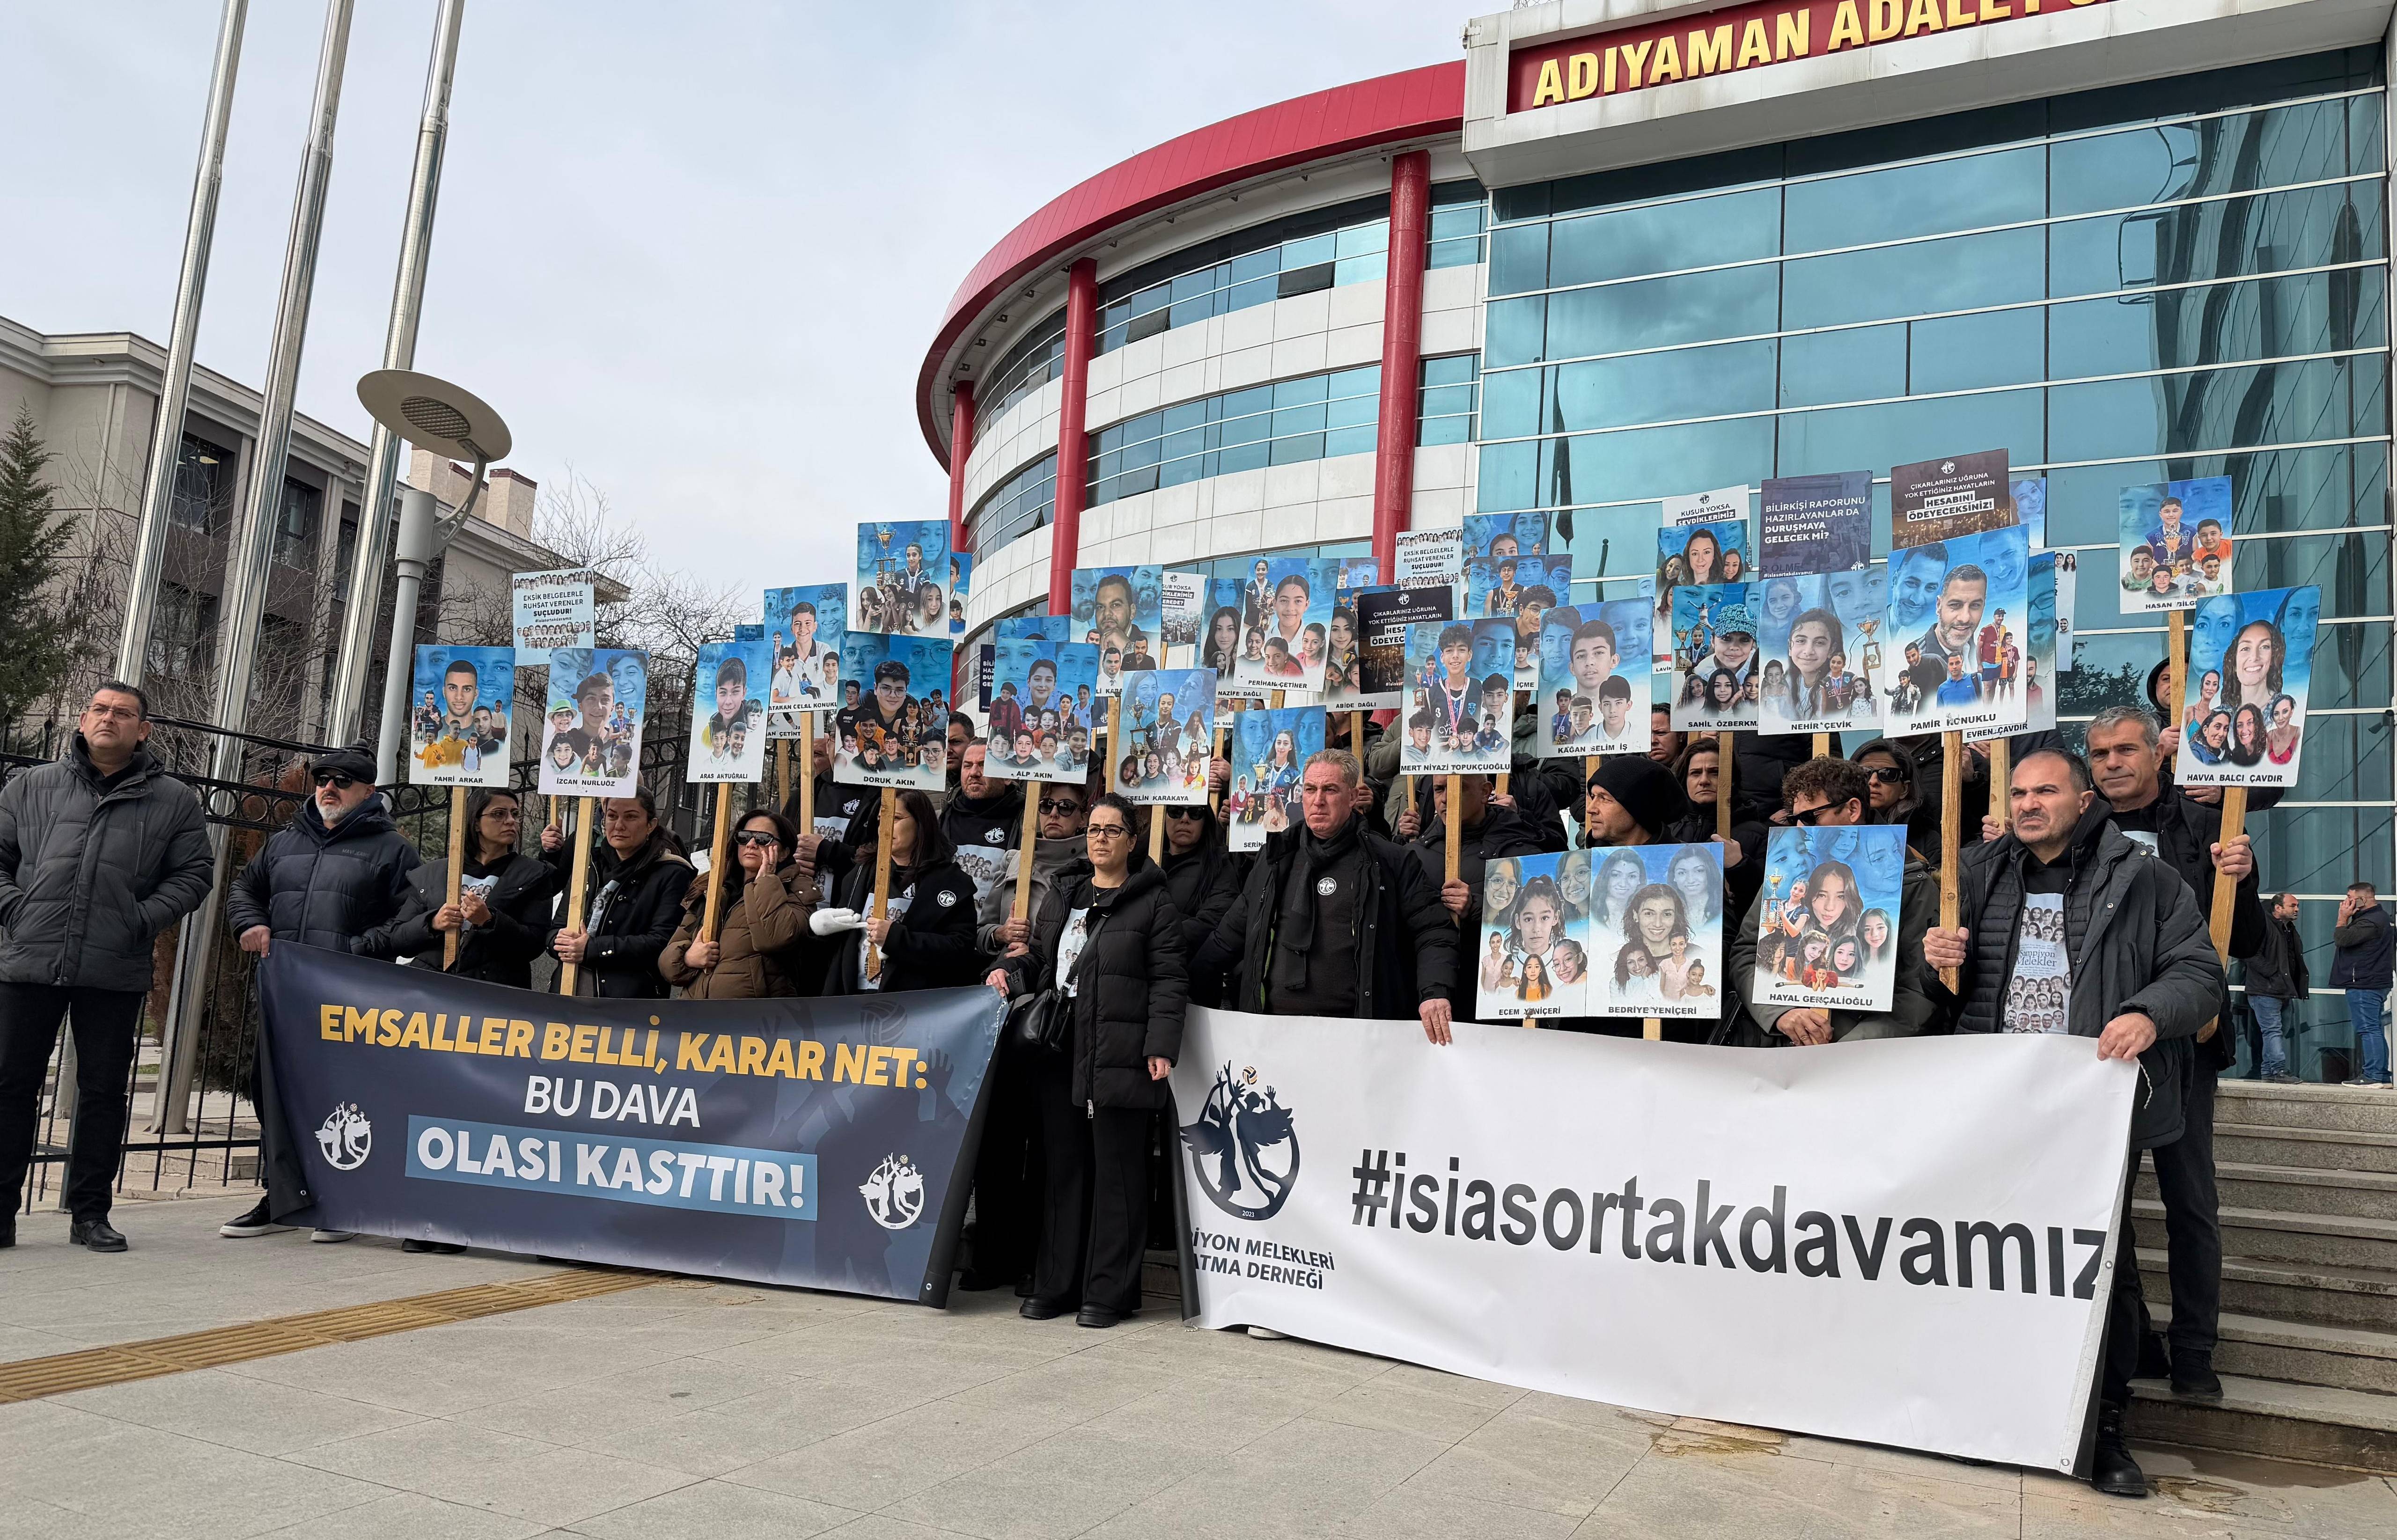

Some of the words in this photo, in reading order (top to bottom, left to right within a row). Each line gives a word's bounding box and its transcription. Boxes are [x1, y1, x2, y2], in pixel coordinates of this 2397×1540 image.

[1532, 8, 1809, 107] ADIYAMAN
[1827, 0, 2040, 50] ADAL
[1911, 477, 1957, 490] ÇIKARLARINIZ
[1958, 472, 1988, 482] UĞRUNA
[1919, 485, 1952, 496] ETTİĞİNİZ
[1954, 480, 1995, 491] HAYATLARIN
[1766, 500, 1807, 513] BİLİRKİŞİ
[1809, 497, 1865, 509] RAPORUNU
[1926, 493, 1973, 507] HESABINI
[1681, 508, 1705, 517] KUSUR
[1706, 503, 1730, 512] YOKSA
[1765, 509, 1844, 523] HAZIRLAYANLAR
[1909, 501, 1992, 520] ÖDEYECEKSİNİZ!
[1677, 510, 1734, 526] SEVDİKLERİMİZ
[1765, 521, 1826, 534] DURUŞMAYA
[1765, 534, 1810, 544] GELECEK
[1812, 530, 1829, 540] Mİ?
[543, 590, 583, 599] BELGELERLE
[534, 608, 572, 617] SUÇLUDUR!
[1373, 609, 1411, 617] ÇIKARLARINIZ
[1372, 636, 1404, 645] ÖDEYEC
[1823, 721, 1852, 730] ÇEVİK
[1911, 719, 1940, 730] PAMİR
[1947, 713, 1996, 726] KONUKLU
[1967, 728, 1993, 738] EVREN
[1998, 723, 2028, 735] ÇAVDIR
[1620, 742, 1627, 751] İŞ
[1451, 763, 1510, 771] TOPUKÇUOĞLU
[863, 776, 891, 784] DORUK
[2250, 774, 2283, 783] ÇAVDIR
[2020, 949, 2055, 958] Şampiyon
[2015, 956, 2057, 967] Melekler
[1803, 996, 1873, 1006] GENÇALİOĞLU
[1524, 1006, 1560, 1015] YNİÇERİ
[1652, 1006, 1697, 1015] YENİÇERİ
[321, 1004, 534, 1058] EMSALLER
[541, 1015, 668, 1074] BELLİ,
[676, 1032, 825, 1081] KARAR
[832, 1043, 927, 1090] NET:
[524, 1075, 583, 1116] BU
[590, 1080, 700, 1128] DAVA
[417, 1126, 561, 1182] OLASI
[576, 1143, 804, 1209] KASTTIR!
[1352, 1149, 2107, 1300] #isiasortakdavamız
[1191, 1227, 1240, 1253] İYON
[1245, 1239, 1335, 1270] MELEKLERİ
[1247, 1261, 1323, 1290] DERNEĞİ
